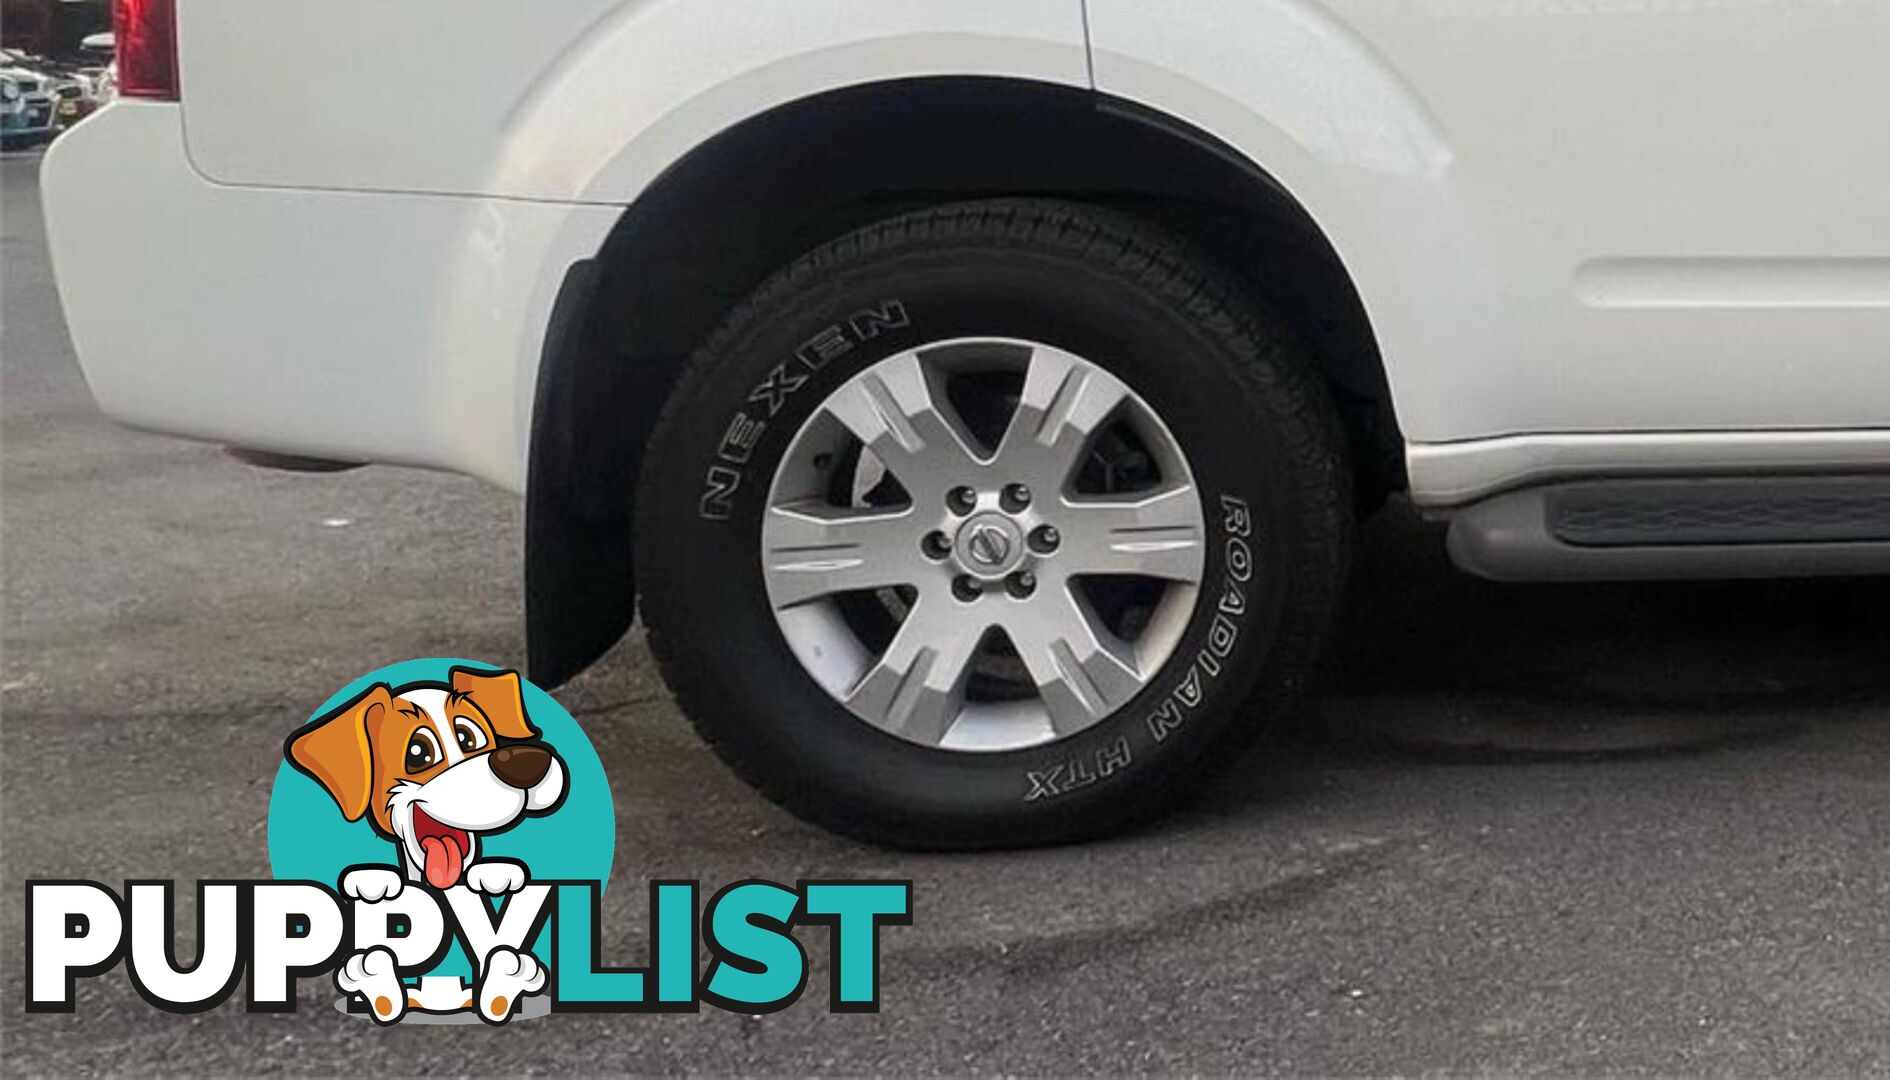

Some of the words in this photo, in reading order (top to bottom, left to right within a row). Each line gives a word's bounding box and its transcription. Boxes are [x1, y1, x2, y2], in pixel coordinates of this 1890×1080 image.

[703, 300, 910, 518] NEXEN
[1147, 494, 1254, 742] ROADIAN
[1024, 737, 1133, 803] HTX
